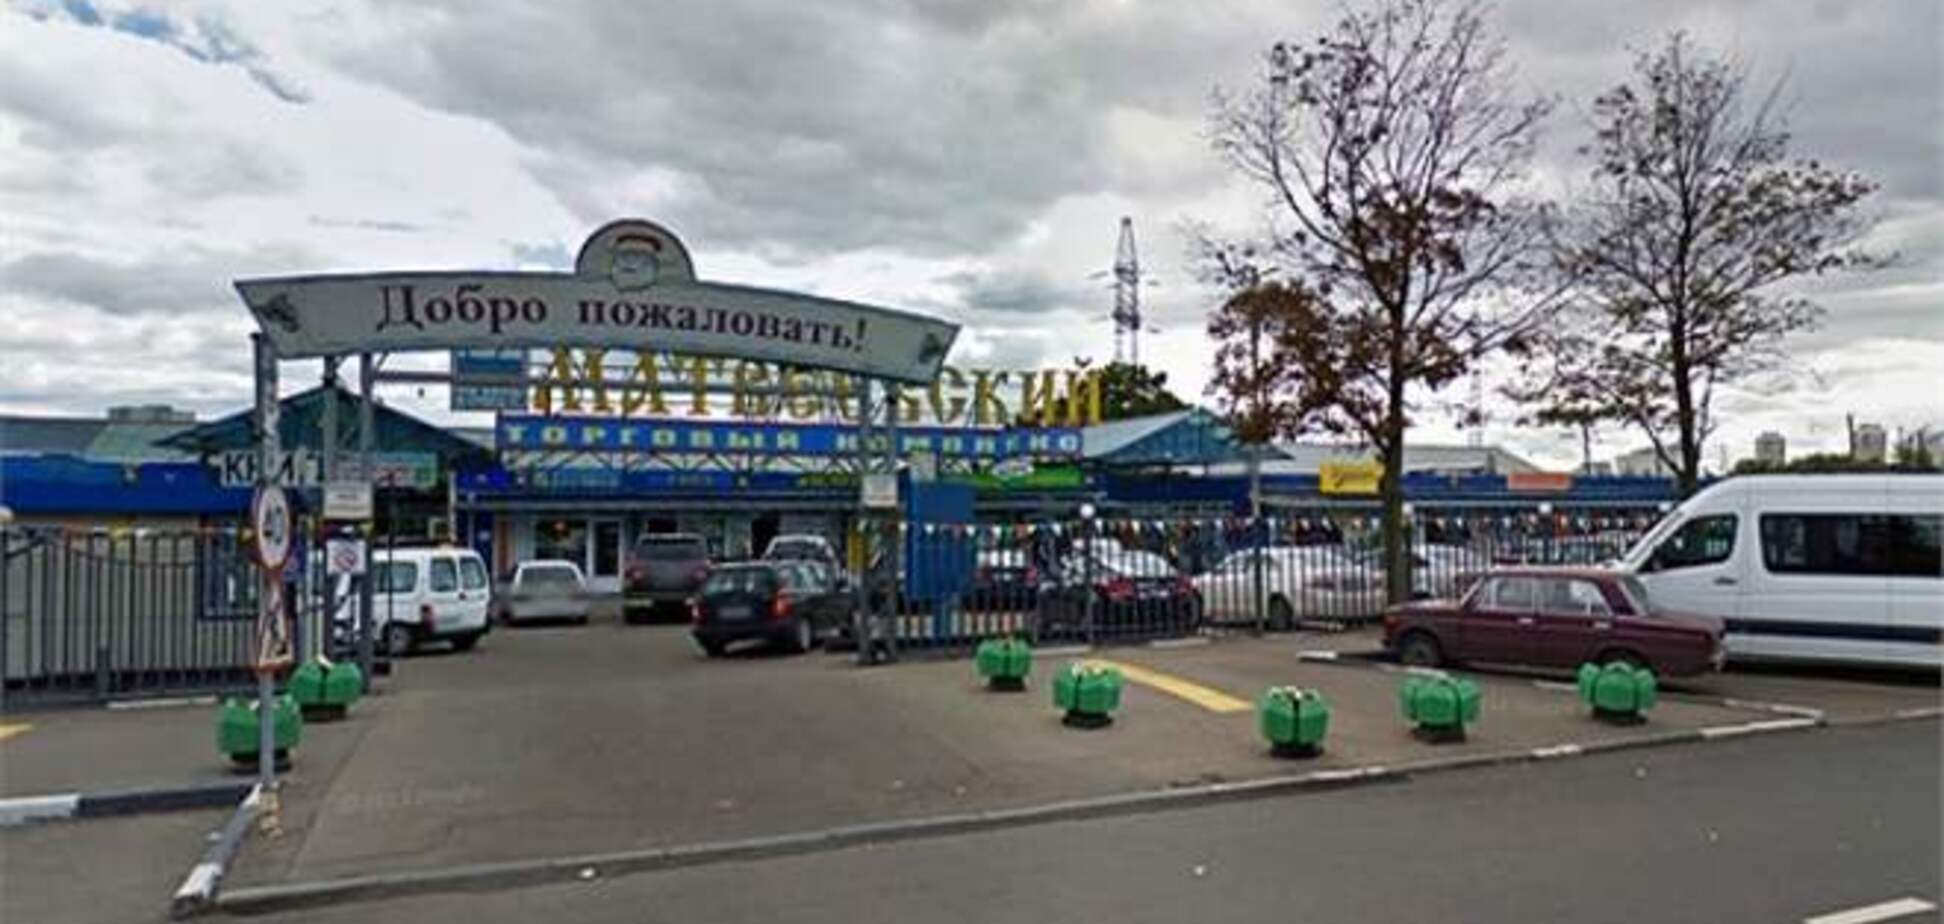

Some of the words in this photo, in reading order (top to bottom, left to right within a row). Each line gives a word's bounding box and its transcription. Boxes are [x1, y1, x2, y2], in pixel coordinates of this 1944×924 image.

[376, 285, 547, 334] Добро
[578, 299, 867, 351] пожаловать!
[505, 425, 799, 449] ТОРГОВЫЙ
